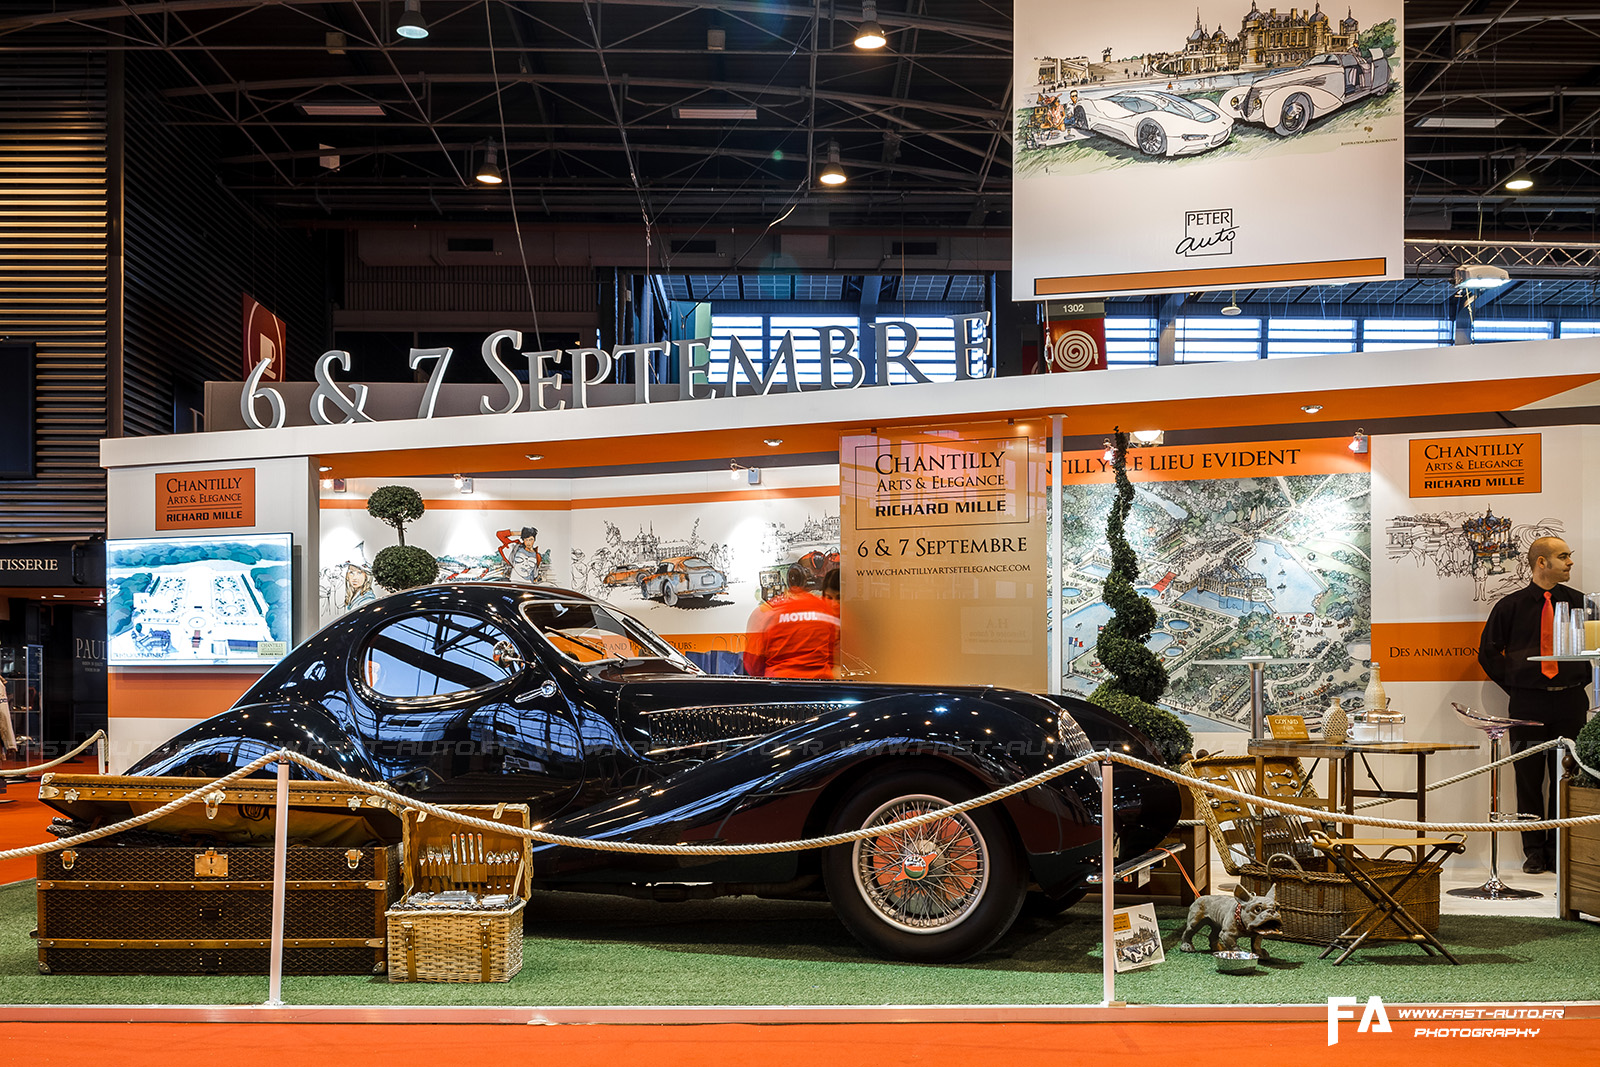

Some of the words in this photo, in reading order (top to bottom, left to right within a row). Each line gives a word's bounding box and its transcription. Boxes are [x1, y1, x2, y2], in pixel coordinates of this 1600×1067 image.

[1187, 211, 1230, 227] PETER
[1175, 225, 1240, 255] auto
[1063, 303, 1084, 313] 1302
[240, 358, 286, 429] 6
[409, 347, 453, 420] 7
[1424, 443, 1524, 460] CHANTILLY
[875, 451, 1005, 475] CHANTILLY
[1151, 454, 1195, 471] LIEU
[1202, 449, 1301, 469] EVIDENT
[1425, 461, 1453, 472] ARTS
[1455, 461, 1464, 470] &
[1468, 459, 1523, 470] ELEGANCE
[166, 477, 242, 493] CHANTILLY
[877, 478, 912, 492] ARTS
[915, 477, 926, 489] &
[932, 474, 1005, 490] ELEGANCE
[1424, 478, 1481, 489] RICHARD
[1485, 477, 1524, 487] MILLE
[167, 495, 188, 505] ARTS
[189, 494, 197, 504] &
[199, 493, 241, 503] ELEGANCE
[166, 511, 210, 522] RICHARD
[212, 510, 242, 520] MILLE
[875, 502, 949, 517] RICHARD
[955, 500, 1006, 513] MILLE
[857, 541, 868, 558] 6
[875, 539, 892, 556] &
[899, 538, 909, 555] 7
[916, 537, 1027, 557] SEPTEMBRE
[779, 611, 818, 623] MOTUL
[76, 638, 107, 660] PAUL
[1389, 647, 1410, 658] DES
